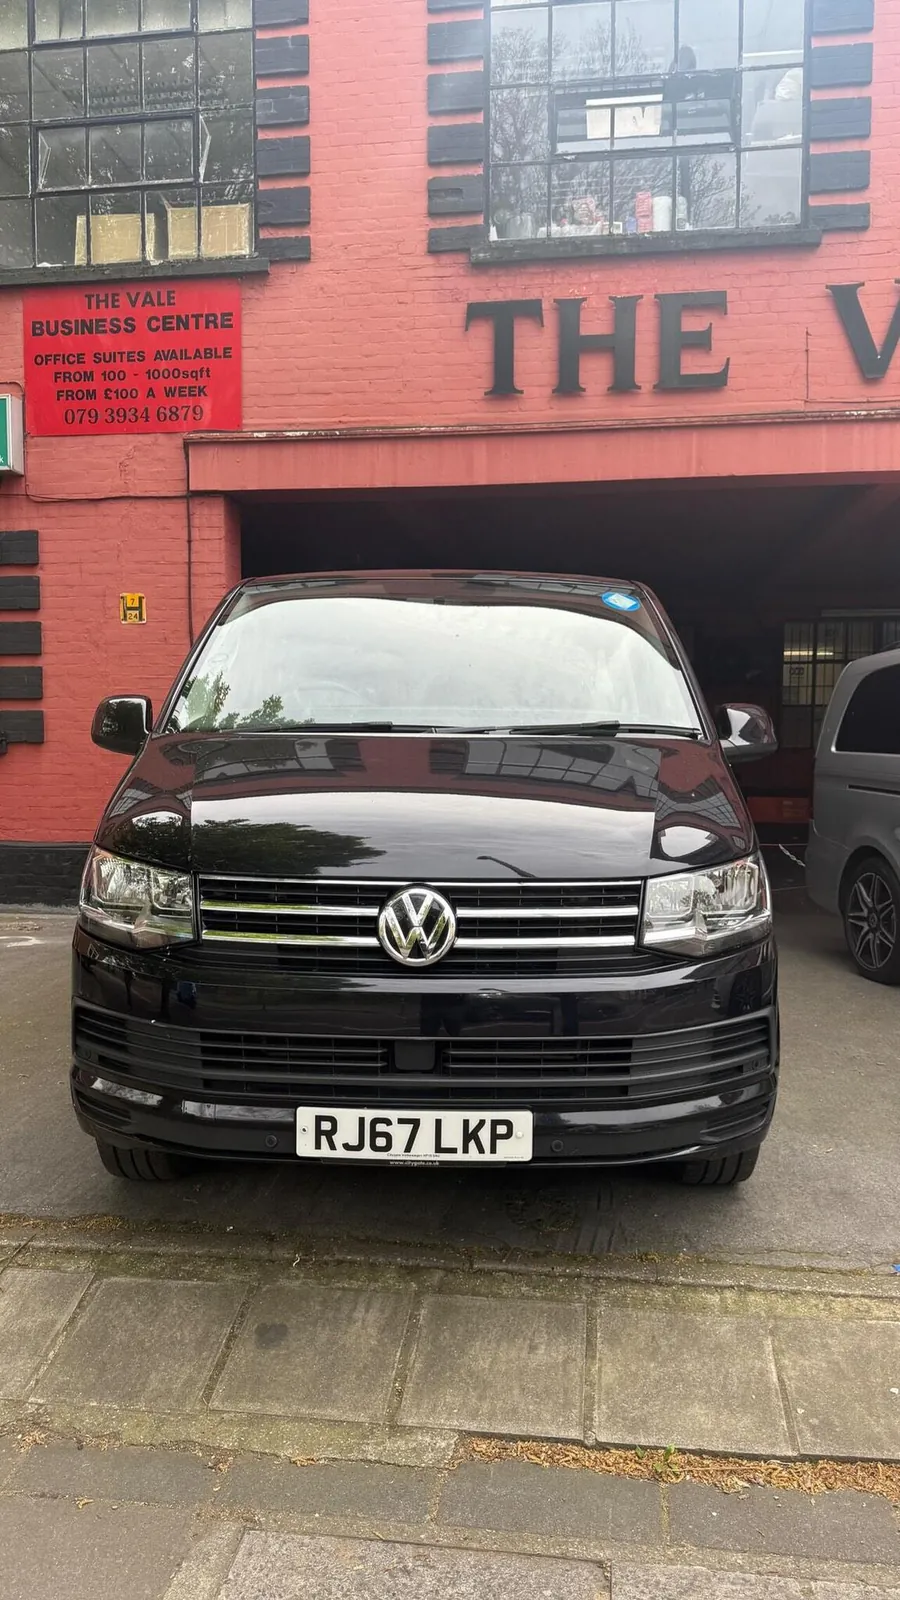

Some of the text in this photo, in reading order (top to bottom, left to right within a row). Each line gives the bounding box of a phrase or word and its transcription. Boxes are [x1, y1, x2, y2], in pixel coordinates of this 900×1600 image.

[85, 290, 176, 309] THE VALE
[31, 312, 233, 337] BUSINESS CENTRE
[465, 290, 730, 396] THE
[34, 347, 232, 366] OFFICE SUITES AVAILABLE
[54, 371, 94, 383] FROM
[101, 370, 126, 381] 100
[145, 367, 211, 382] 1000sqft
[57, 385, 208, 401] FROM £100 A WEEK
[64, 405, 204, 425] 079 3934 6879
[130, 598, 135, 606] 7
[128, 612, 138, 620] 24
[314, 1115, 514, 1154] RJ67 LKP
